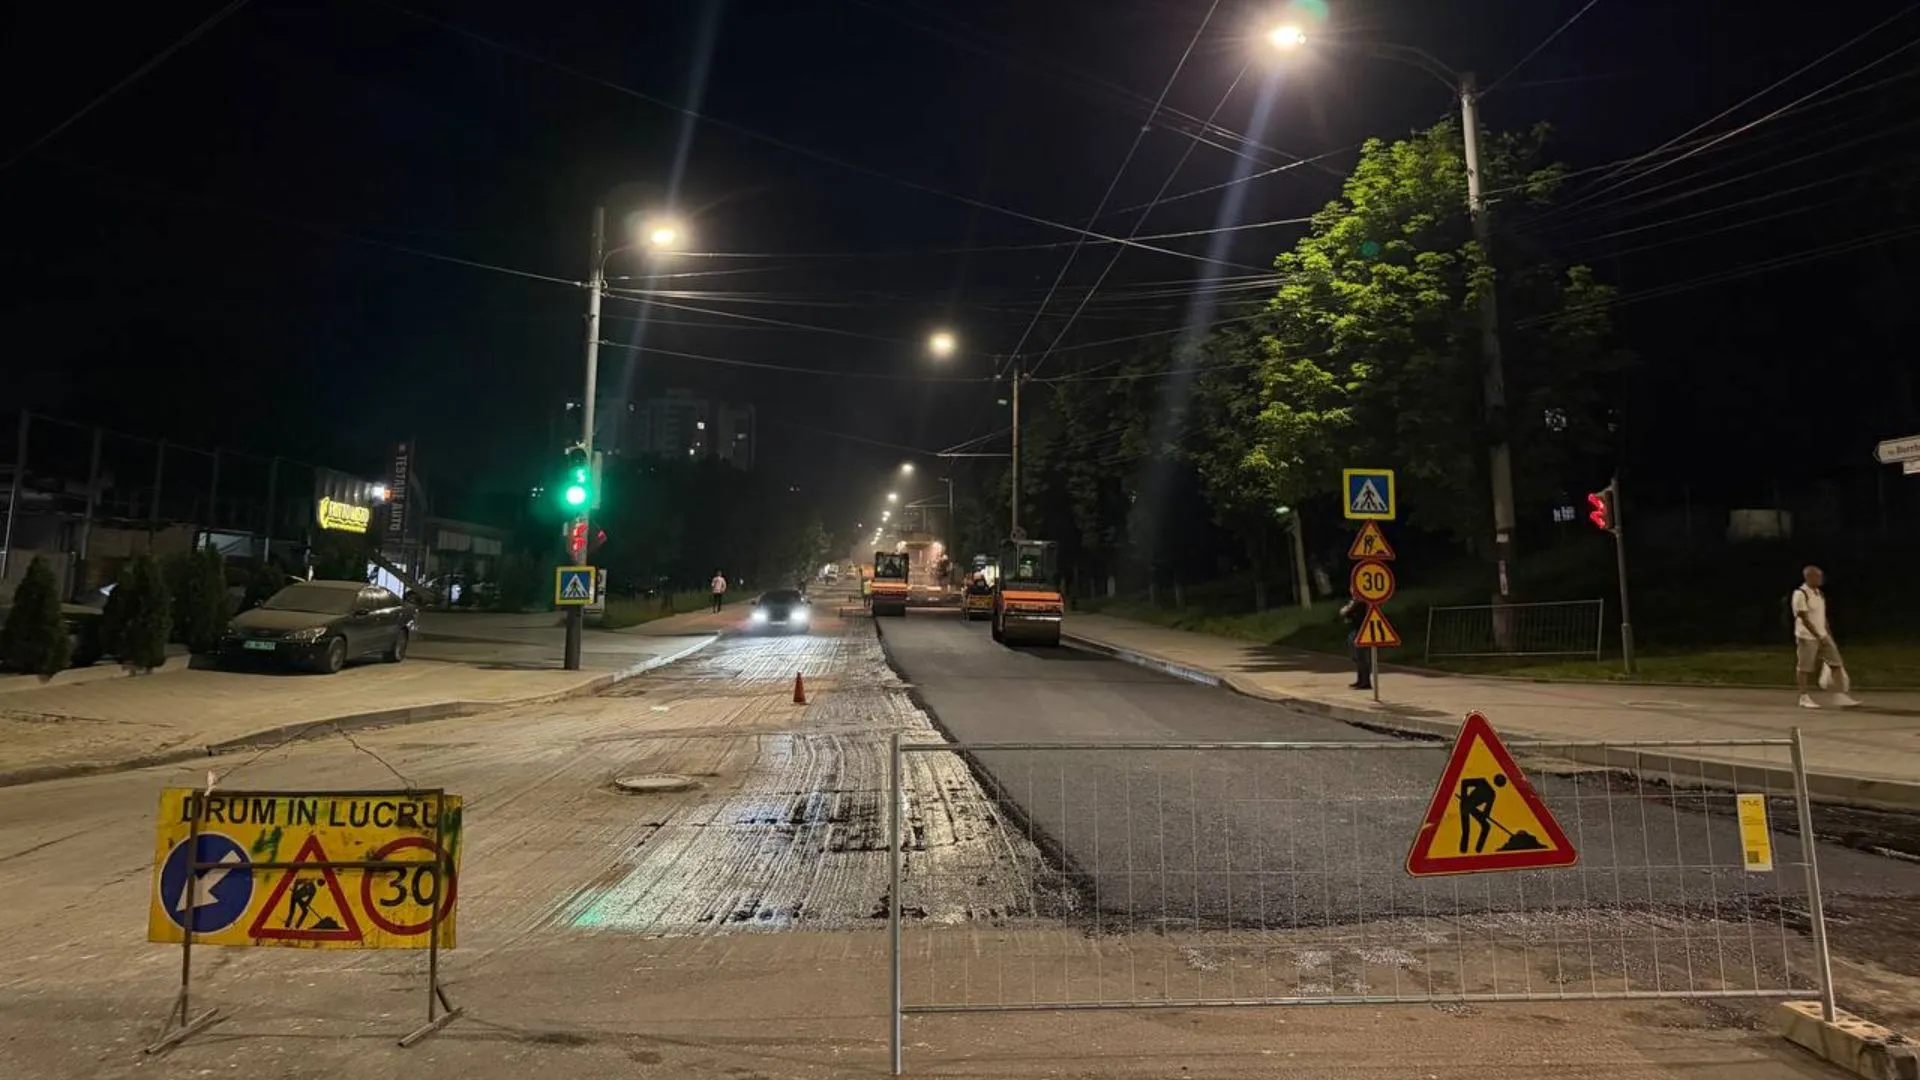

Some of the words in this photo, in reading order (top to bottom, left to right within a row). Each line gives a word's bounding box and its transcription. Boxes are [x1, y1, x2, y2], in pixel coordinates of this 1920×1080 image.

[1363, 572, 1384, 591] 30
[181, 796, 276, 824] DRUM
[286, 799, 317, 826] IN
[329, 799, 440, 829] LUCRU
[379, 864, 438, 907] 30
